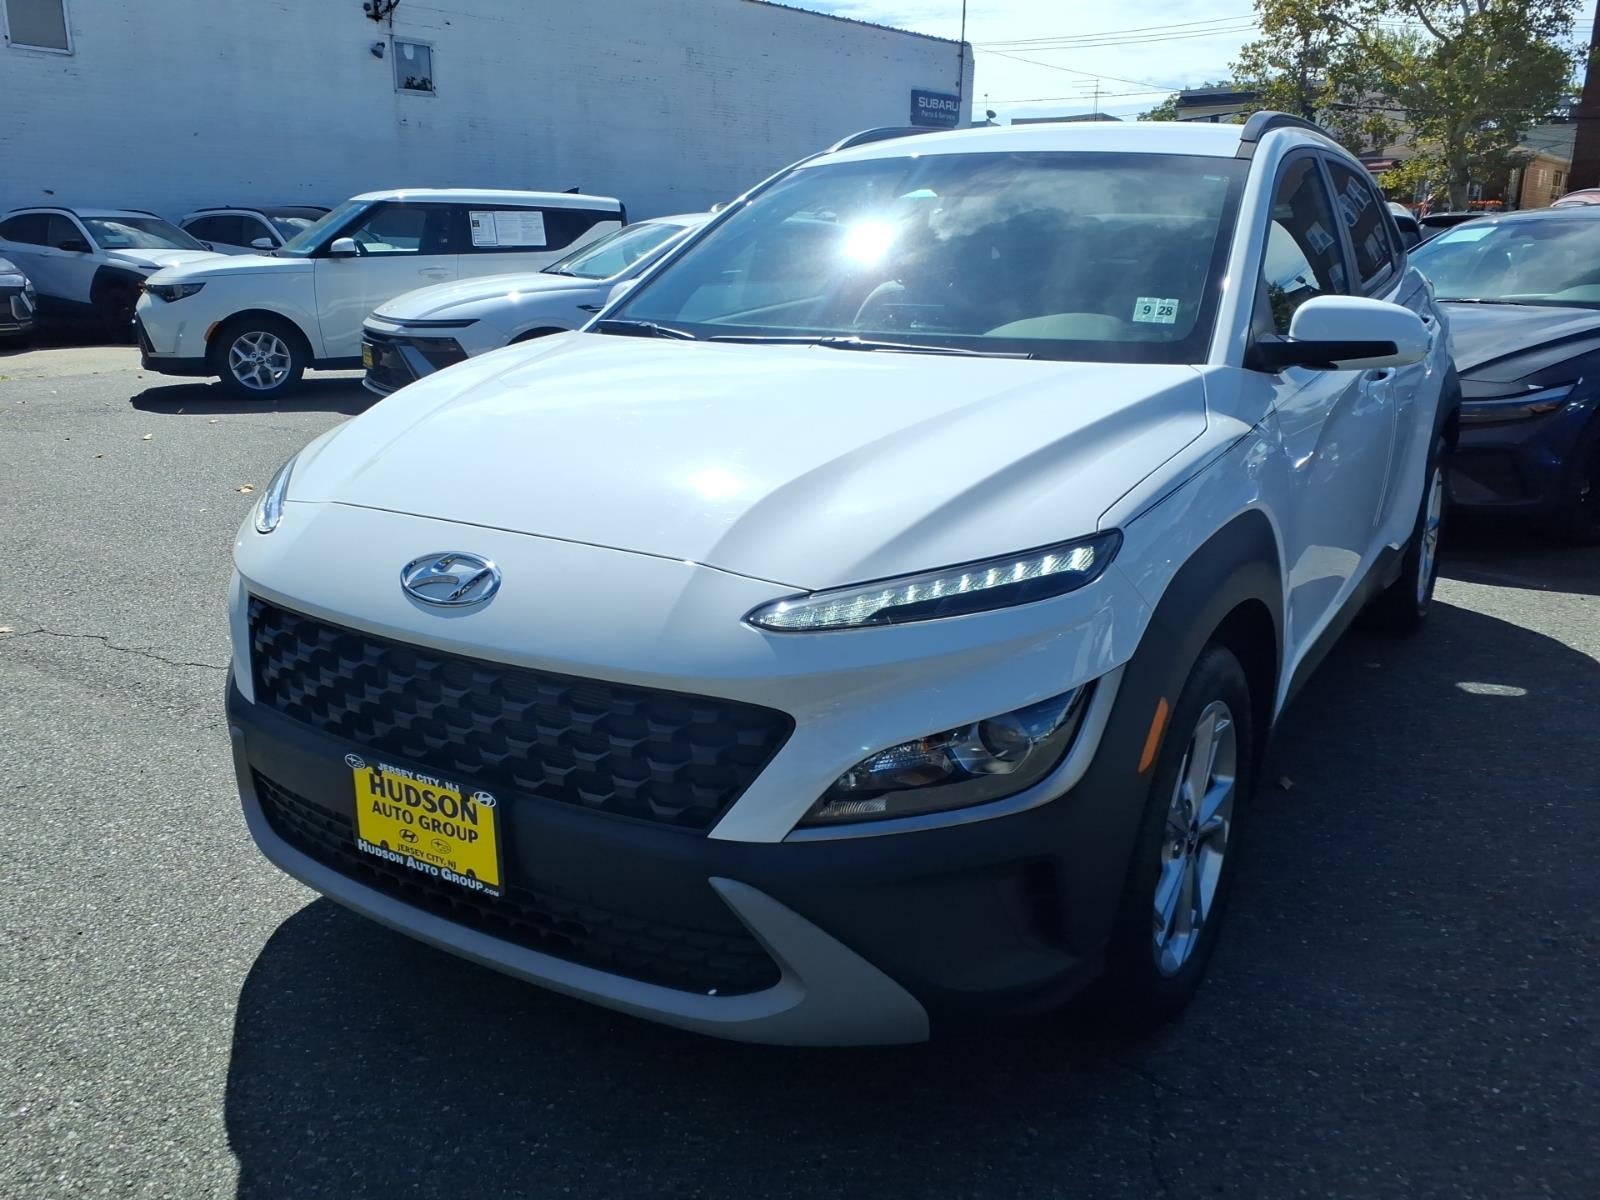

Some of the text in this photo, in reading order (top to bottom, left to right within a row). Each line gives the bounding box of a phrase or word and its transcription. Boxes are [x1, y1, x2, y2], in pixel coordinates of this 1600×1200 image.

[918, 96, 959, 112] SUBARU
[1143, 305, 1173, 316] 9 28
[377, 762, 414, 780] JERSEY
[444, 781, 460, 793] NJ
[369, 773, 478, 826] HUDSON
[372, 800, 479, 844] AUTO GROUP
[397, 843, 425, 858] JERSEY
[447, 859, 457, 871] NJ
